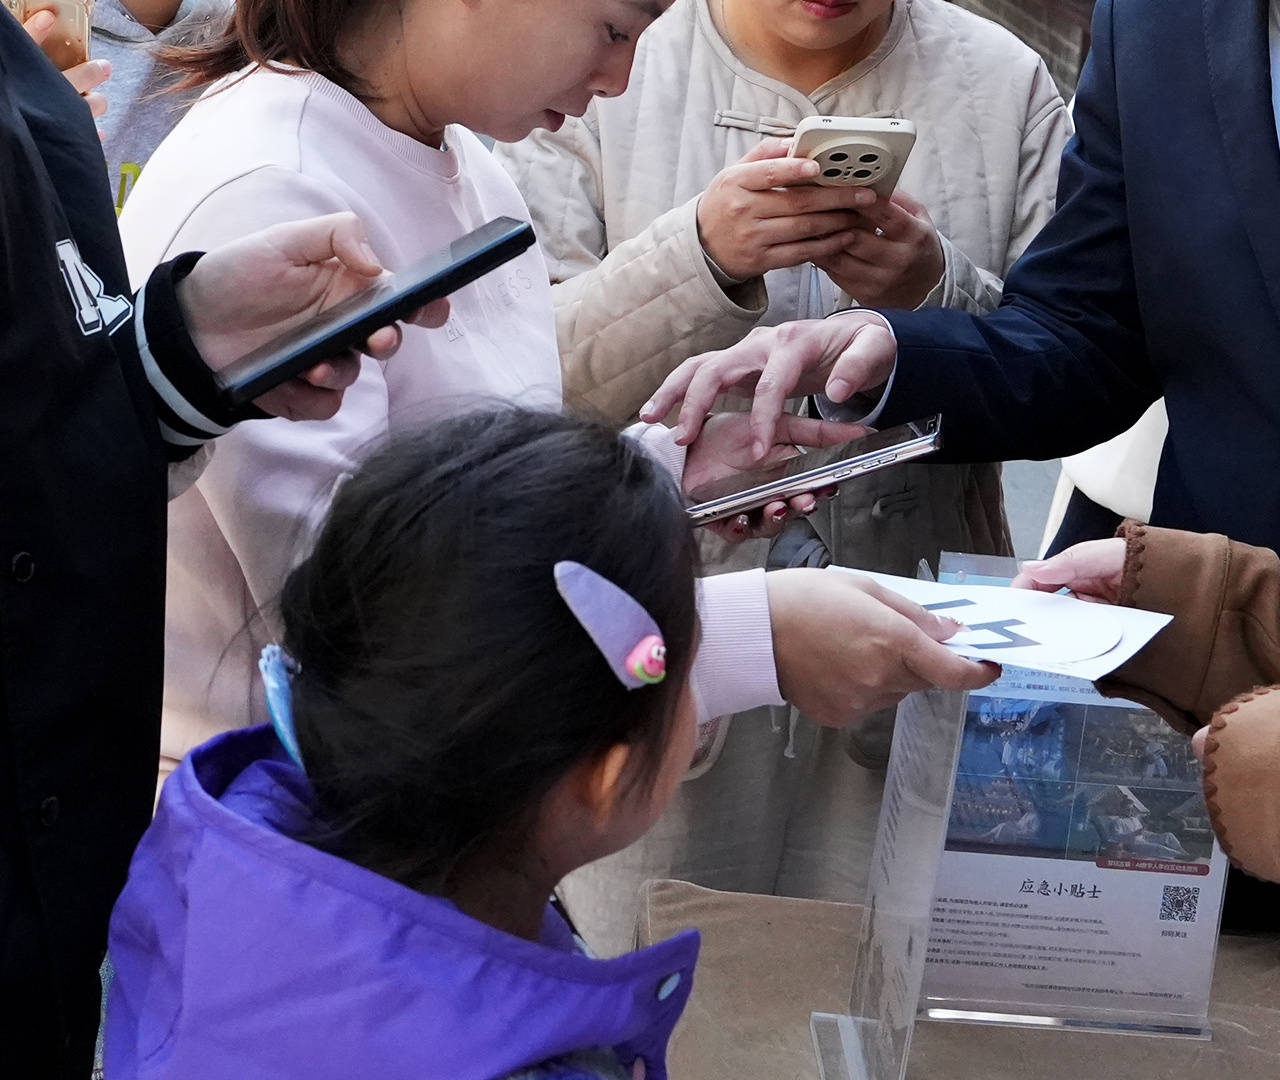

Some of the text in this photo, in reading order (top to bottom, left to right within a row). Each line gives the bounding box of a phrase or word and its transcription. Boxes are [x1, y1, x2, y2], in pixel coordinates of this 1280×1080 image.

[1018, 878, 1103, 900] 应急小贴士
